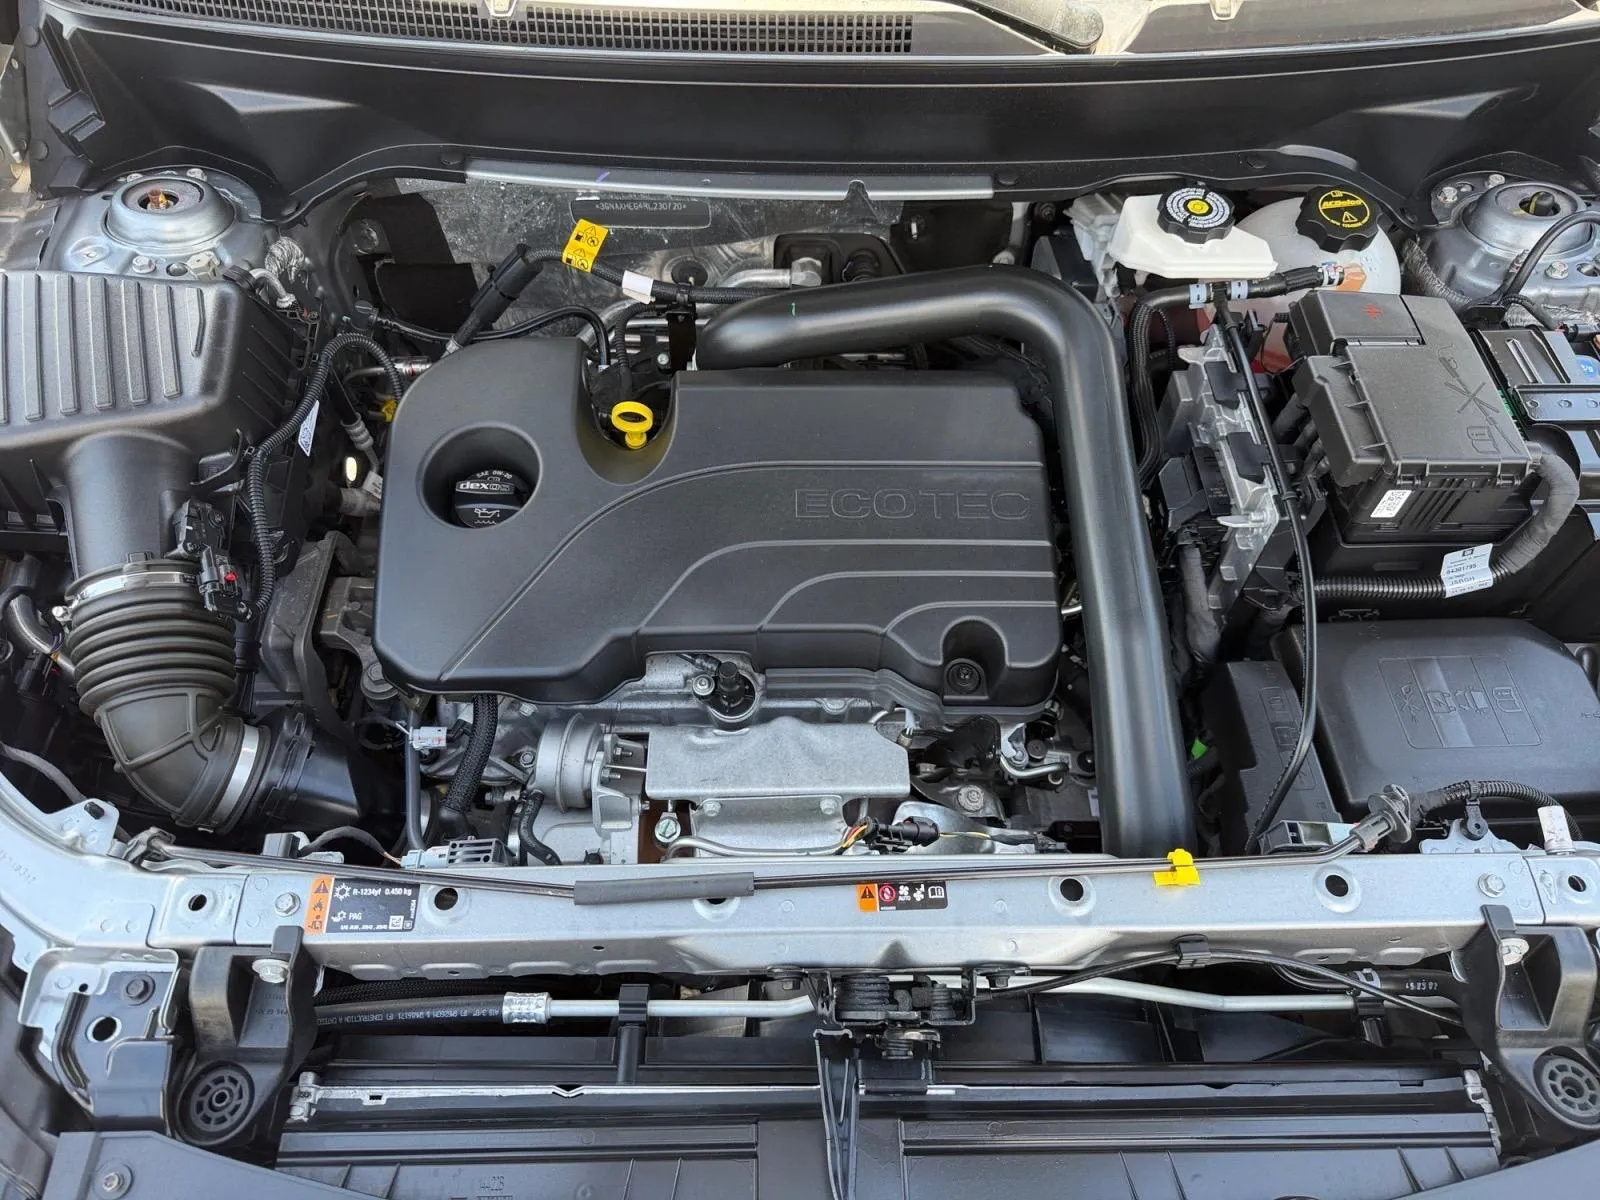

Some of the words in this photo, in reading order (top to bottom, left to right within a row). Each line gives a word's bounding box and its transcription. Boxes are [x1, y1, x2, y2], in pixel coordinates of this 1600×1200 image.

[460, 481, 511, 491] dexos
[795, 488, 1030, 520] ECOTEC
[353, 887, 382, 897] R-1234yf
[384, 887, 402, 897] 0.450
[403, 887, 412, 897] kg
[349, 912, 362, 921] PAG
